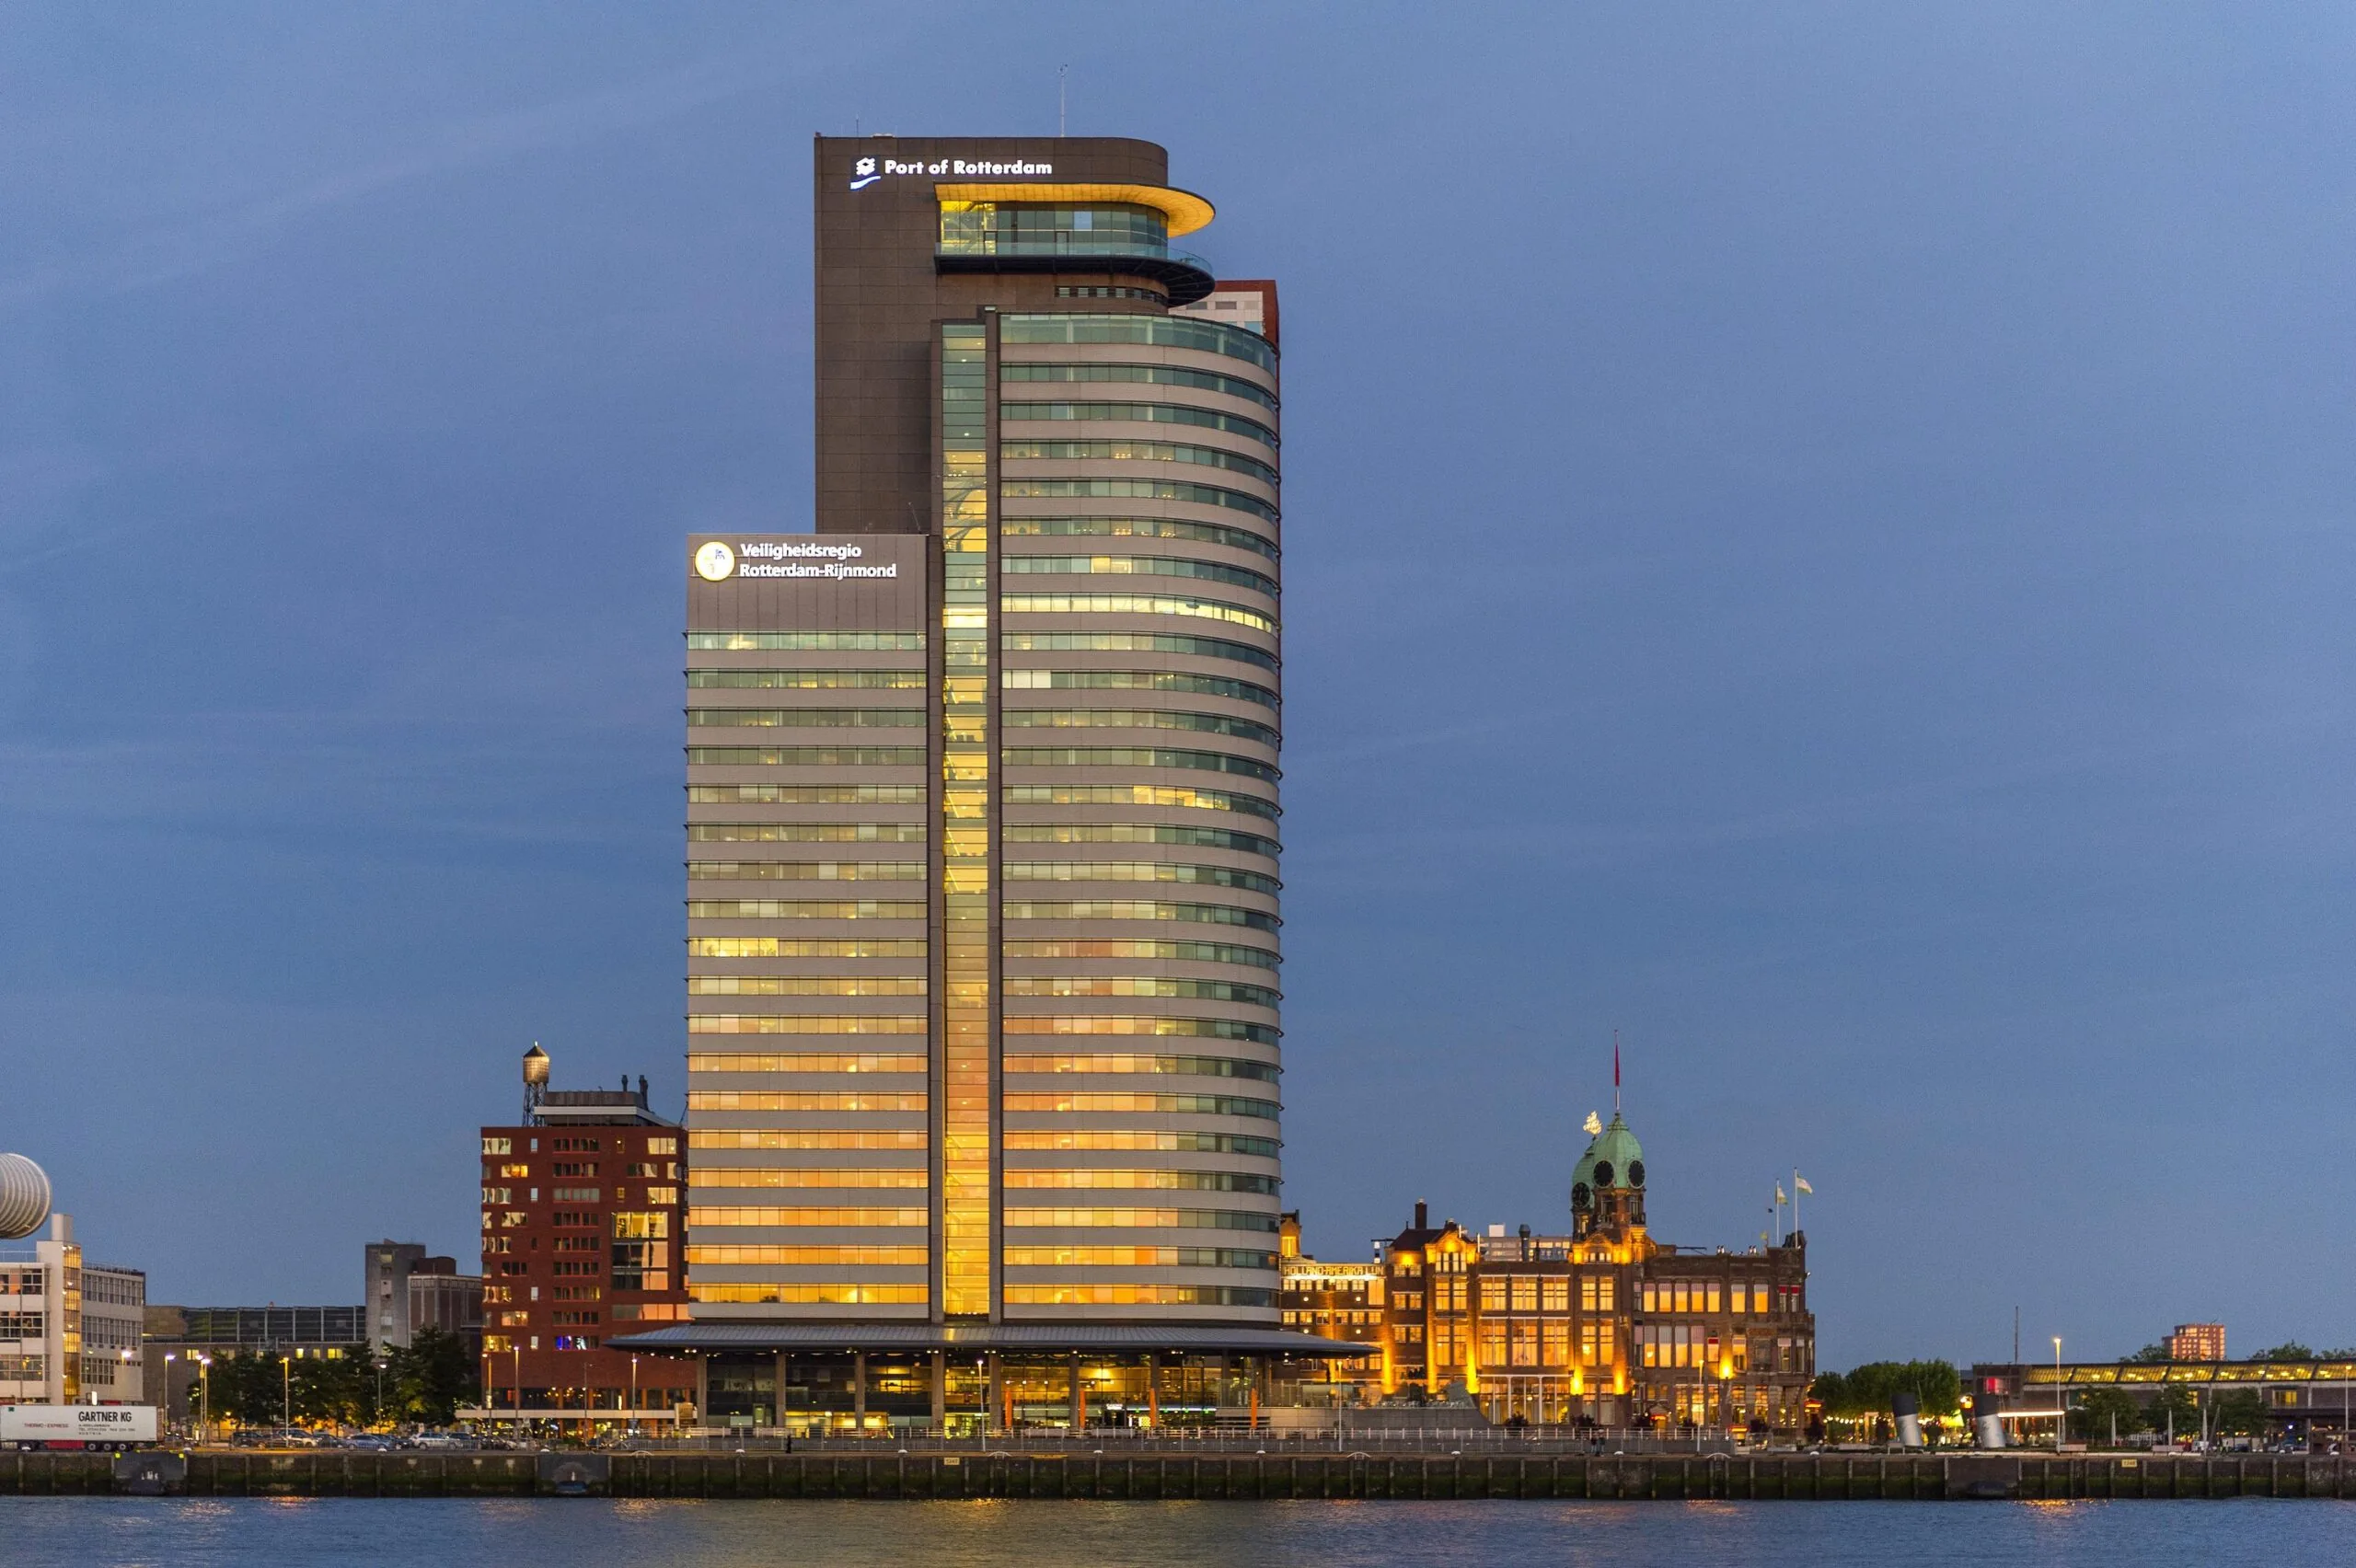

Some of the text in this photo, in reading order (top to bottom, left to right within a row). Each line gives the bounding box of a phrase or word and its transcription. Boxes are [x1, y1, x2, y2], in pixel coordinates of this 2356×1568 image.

[884, 159, 1053, 175] Port of Rotterdam
[740, 543, 861, 560] Veiligheidsregio
[740, 563, 897, 581] Rotterdam-Rijnmond
[1284, 1265, 1363, 1275] HOLLAND-AMERIKA
[78, 1411, 133, 1423] GARTNER KG
